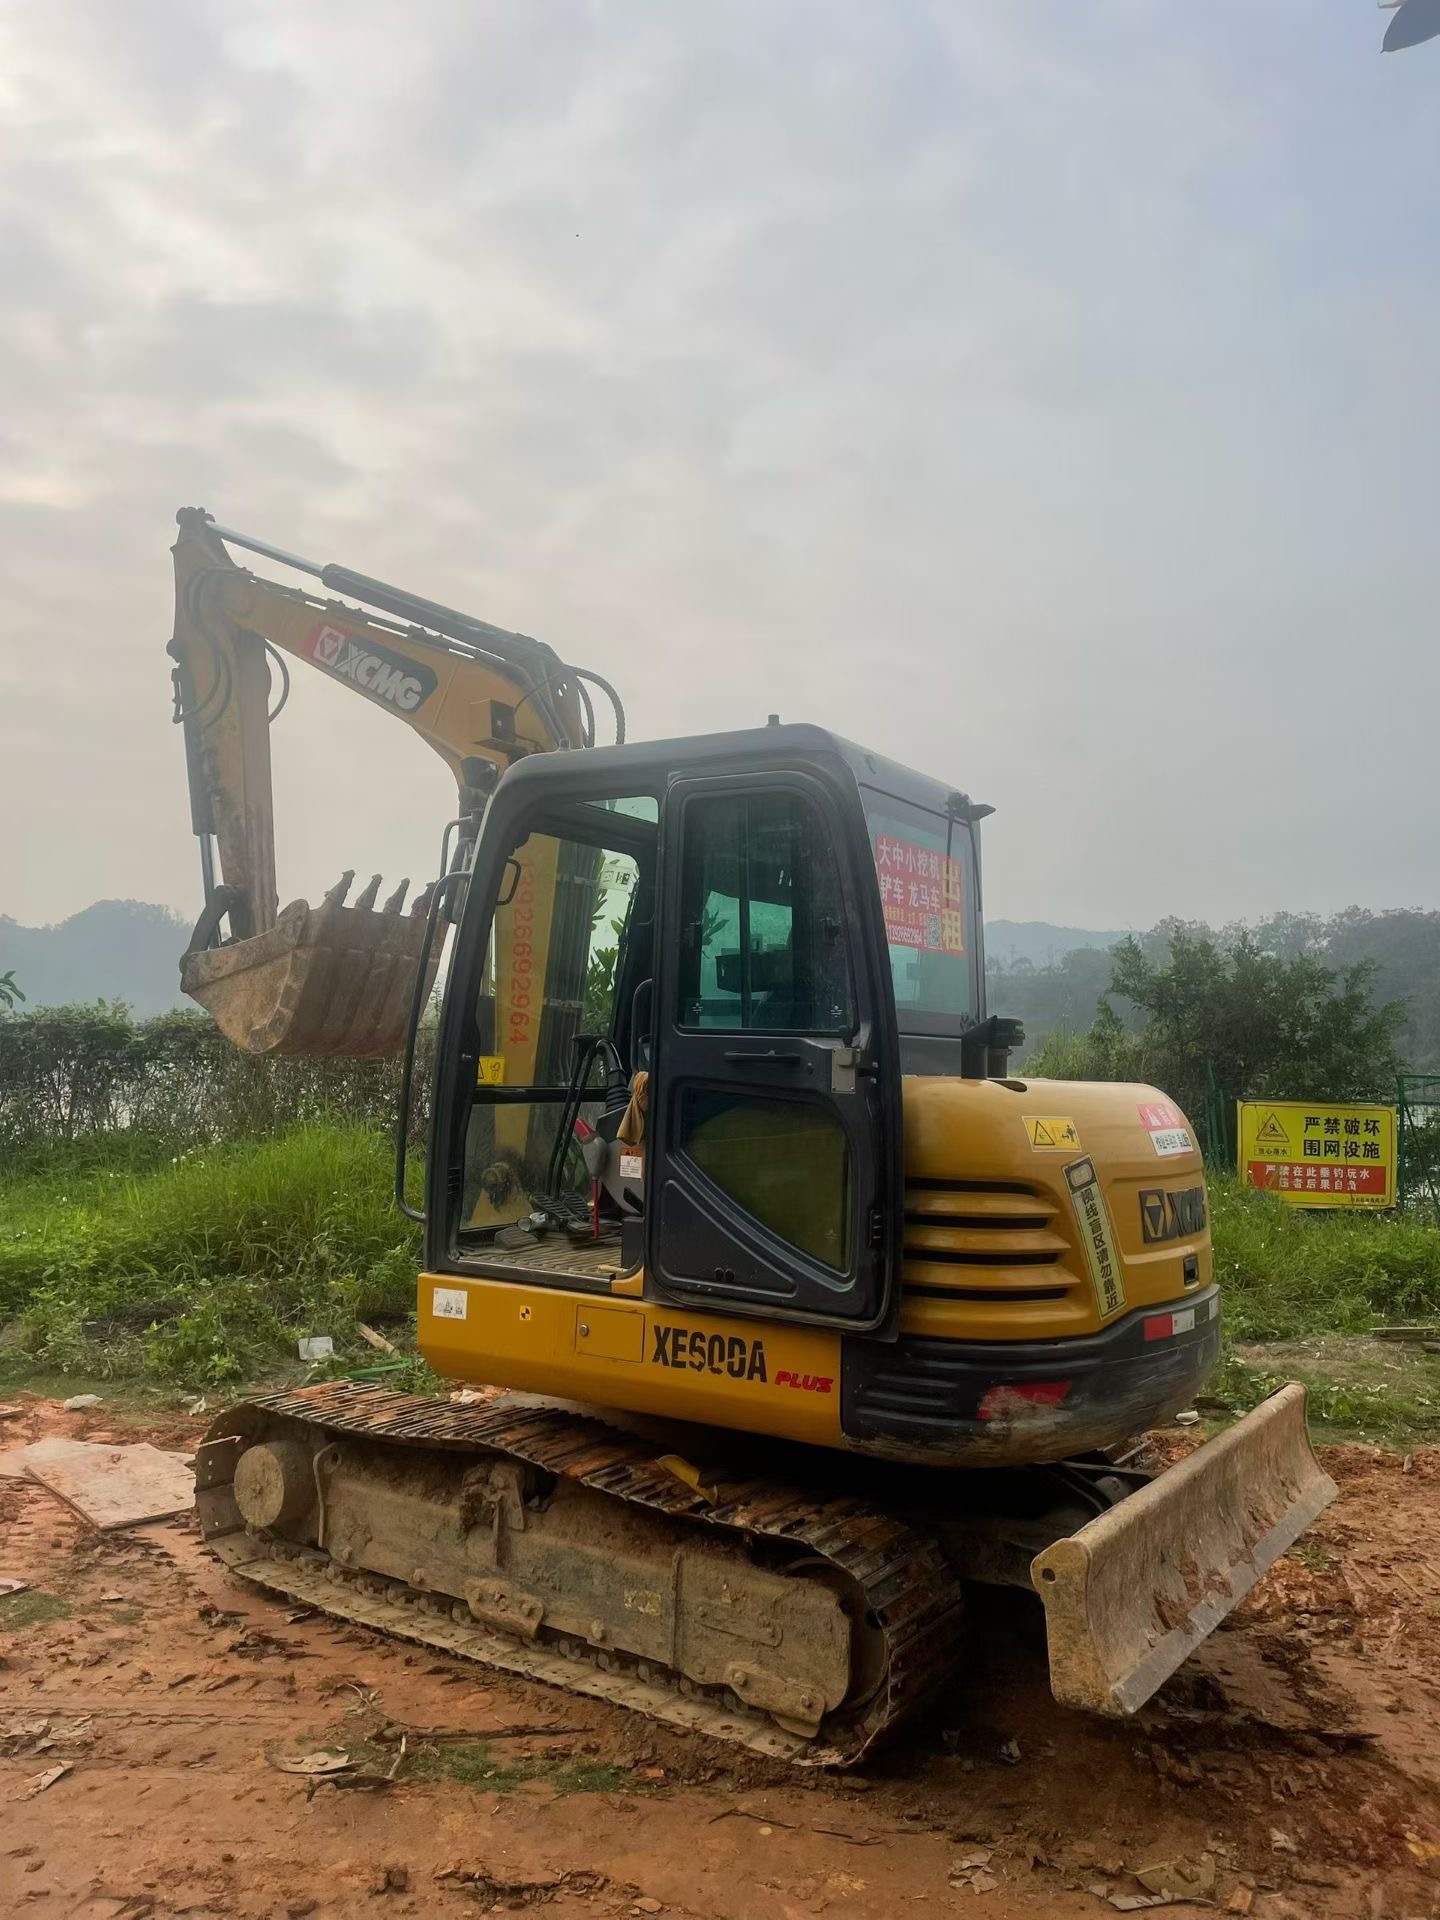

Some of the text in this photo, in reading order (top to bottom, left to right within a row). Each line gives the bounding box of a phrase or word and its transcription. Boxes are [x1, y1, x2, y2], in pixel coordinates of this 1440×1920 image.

[334, 641, 422, 710] XCMG
[880, 838, 941, 880] 大中小挖机
[942, 858, 963, 951] 出租
[509, 863, 535, 1044] 926692964
[1303, 1139, 1380, 1159] 围网设施
[1304, 1116, 1380, 1136] 严禁破坏
[1080, 1187, 1119, 1311] 视线盲区请勿靠近
[774, 1369, 834, 1394] PLUS
